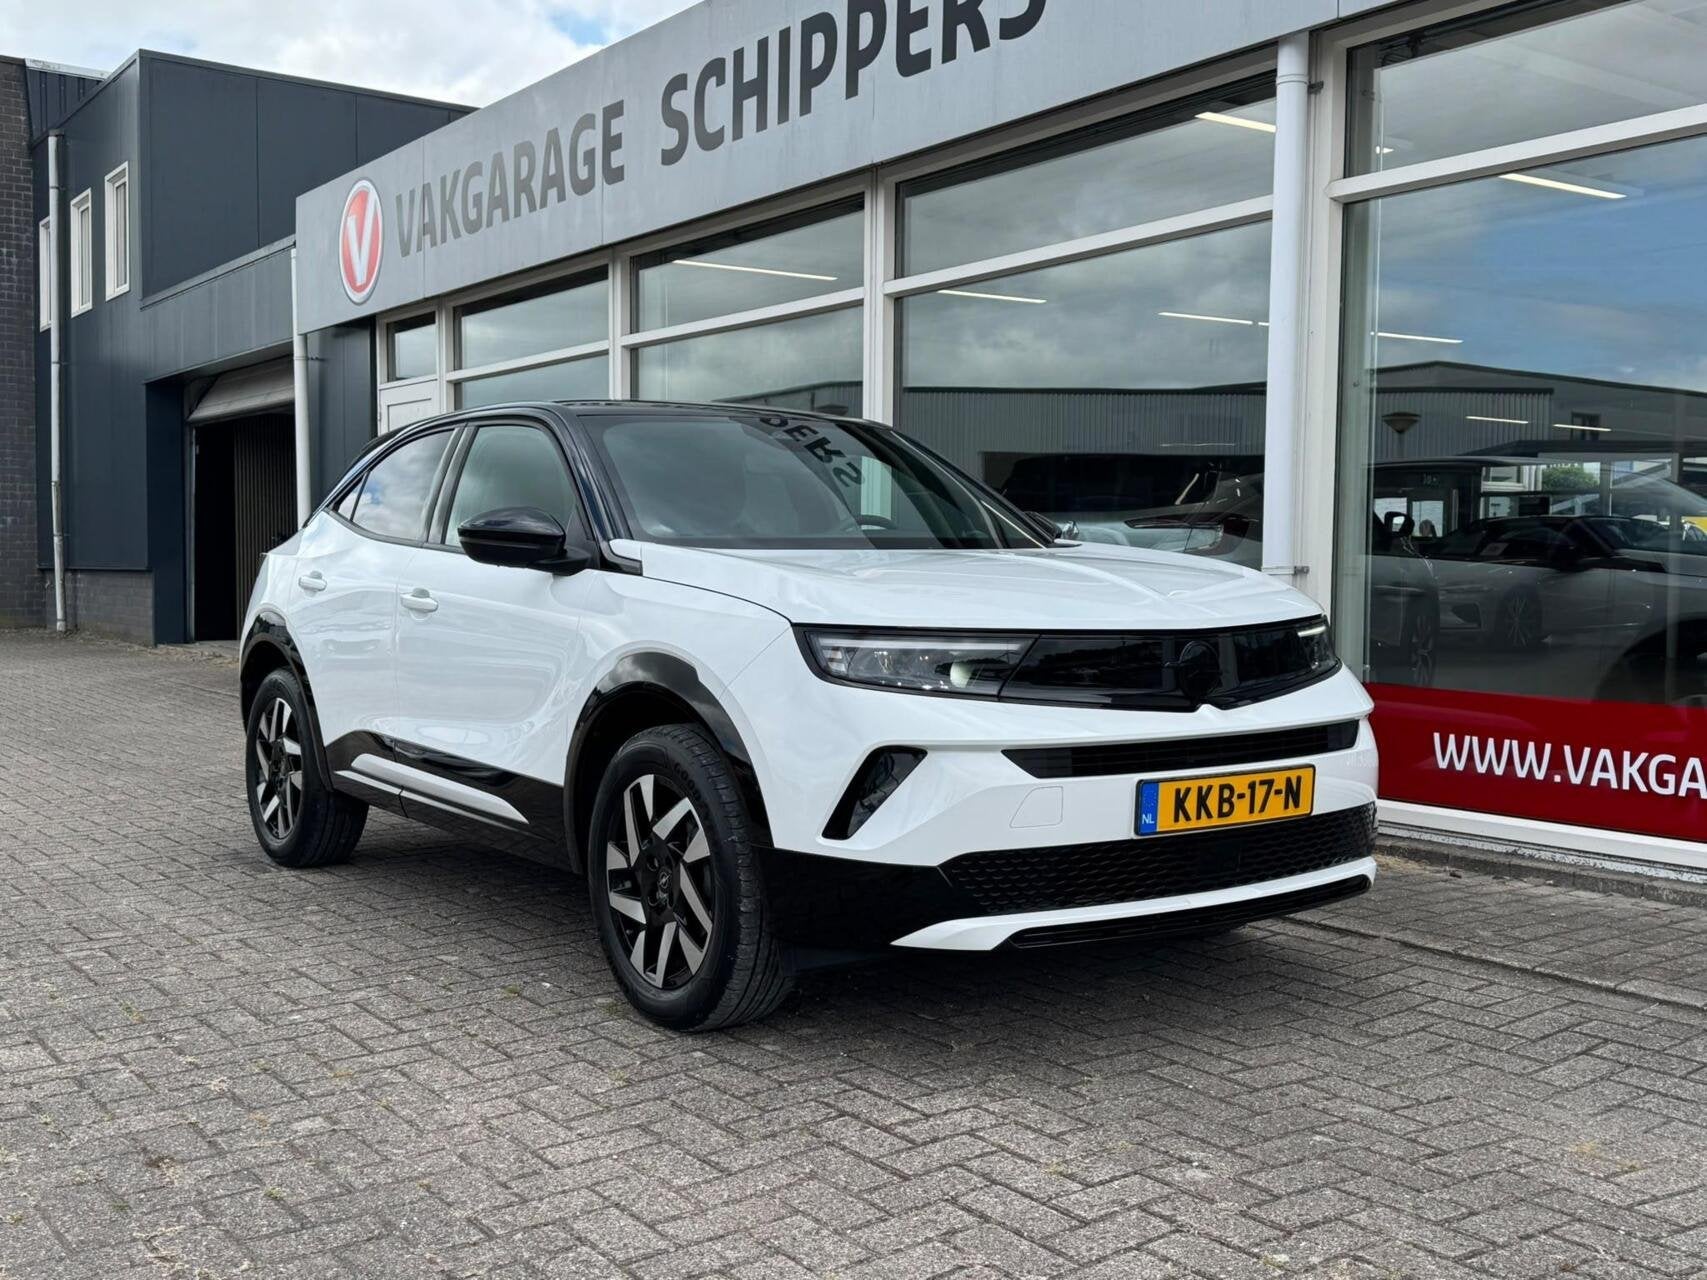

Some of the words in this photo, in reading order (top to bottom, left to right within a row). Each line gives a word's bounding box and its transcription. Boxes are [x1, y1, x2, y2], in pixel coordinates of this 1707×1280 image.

[395, 99, 625, 258] VAKGARAGE
[1433, 732, 1707, 800] WWW.VAKGA
[1142, 813, 1155, 824] NL
[1174, 775, 1302, 824] KKB-17-N
